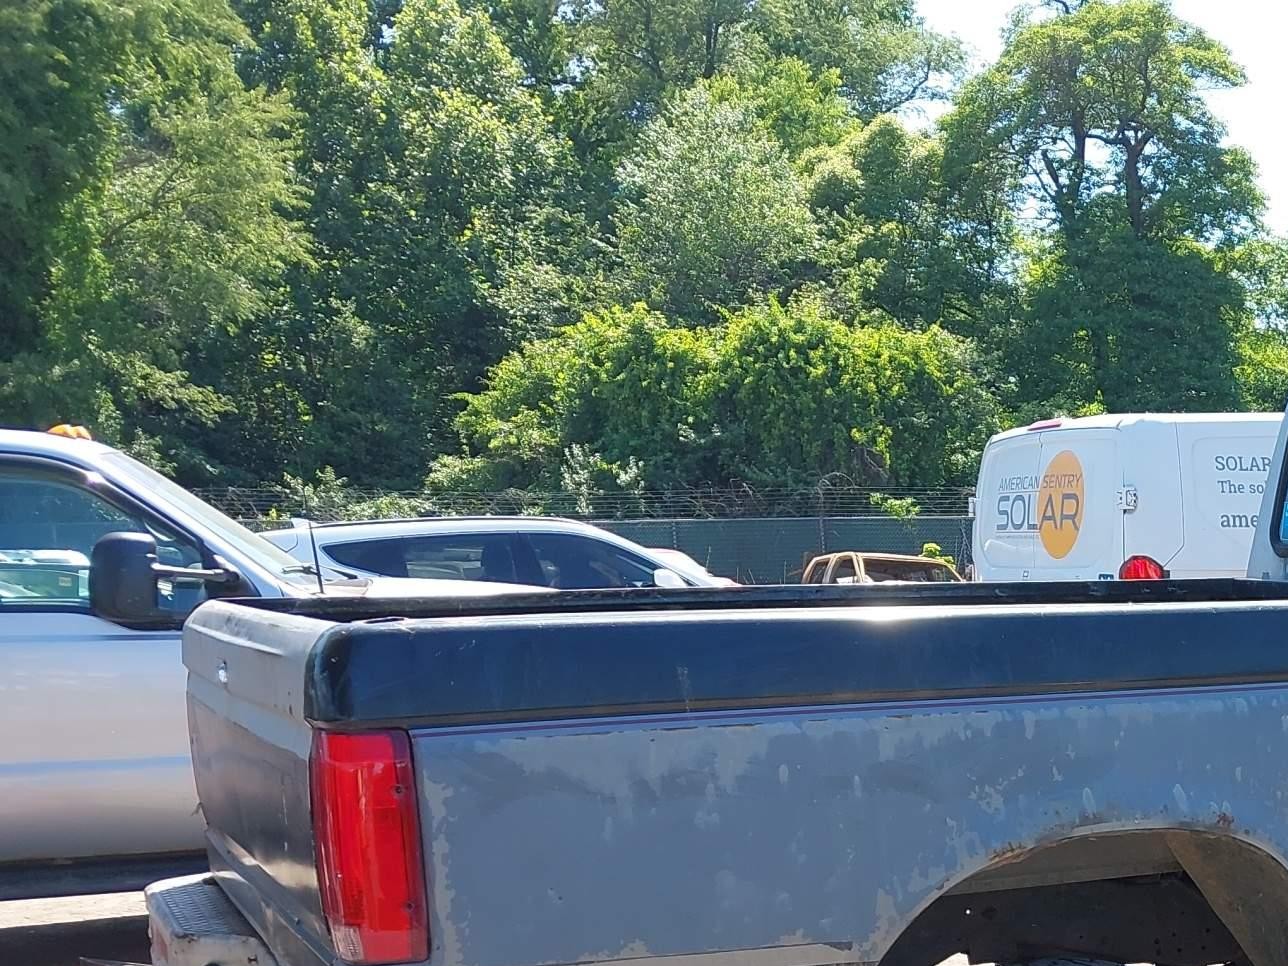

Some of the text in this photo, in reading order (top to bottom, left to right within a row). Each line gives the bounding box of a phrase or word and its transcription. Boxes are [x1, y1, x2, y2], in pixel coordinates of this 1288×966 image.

[999, 474, 1082, 491] AMERICAN SENTRY
[1217, 480, 1245, 493] The
[996, 493, 1080, 530] SOLAR
